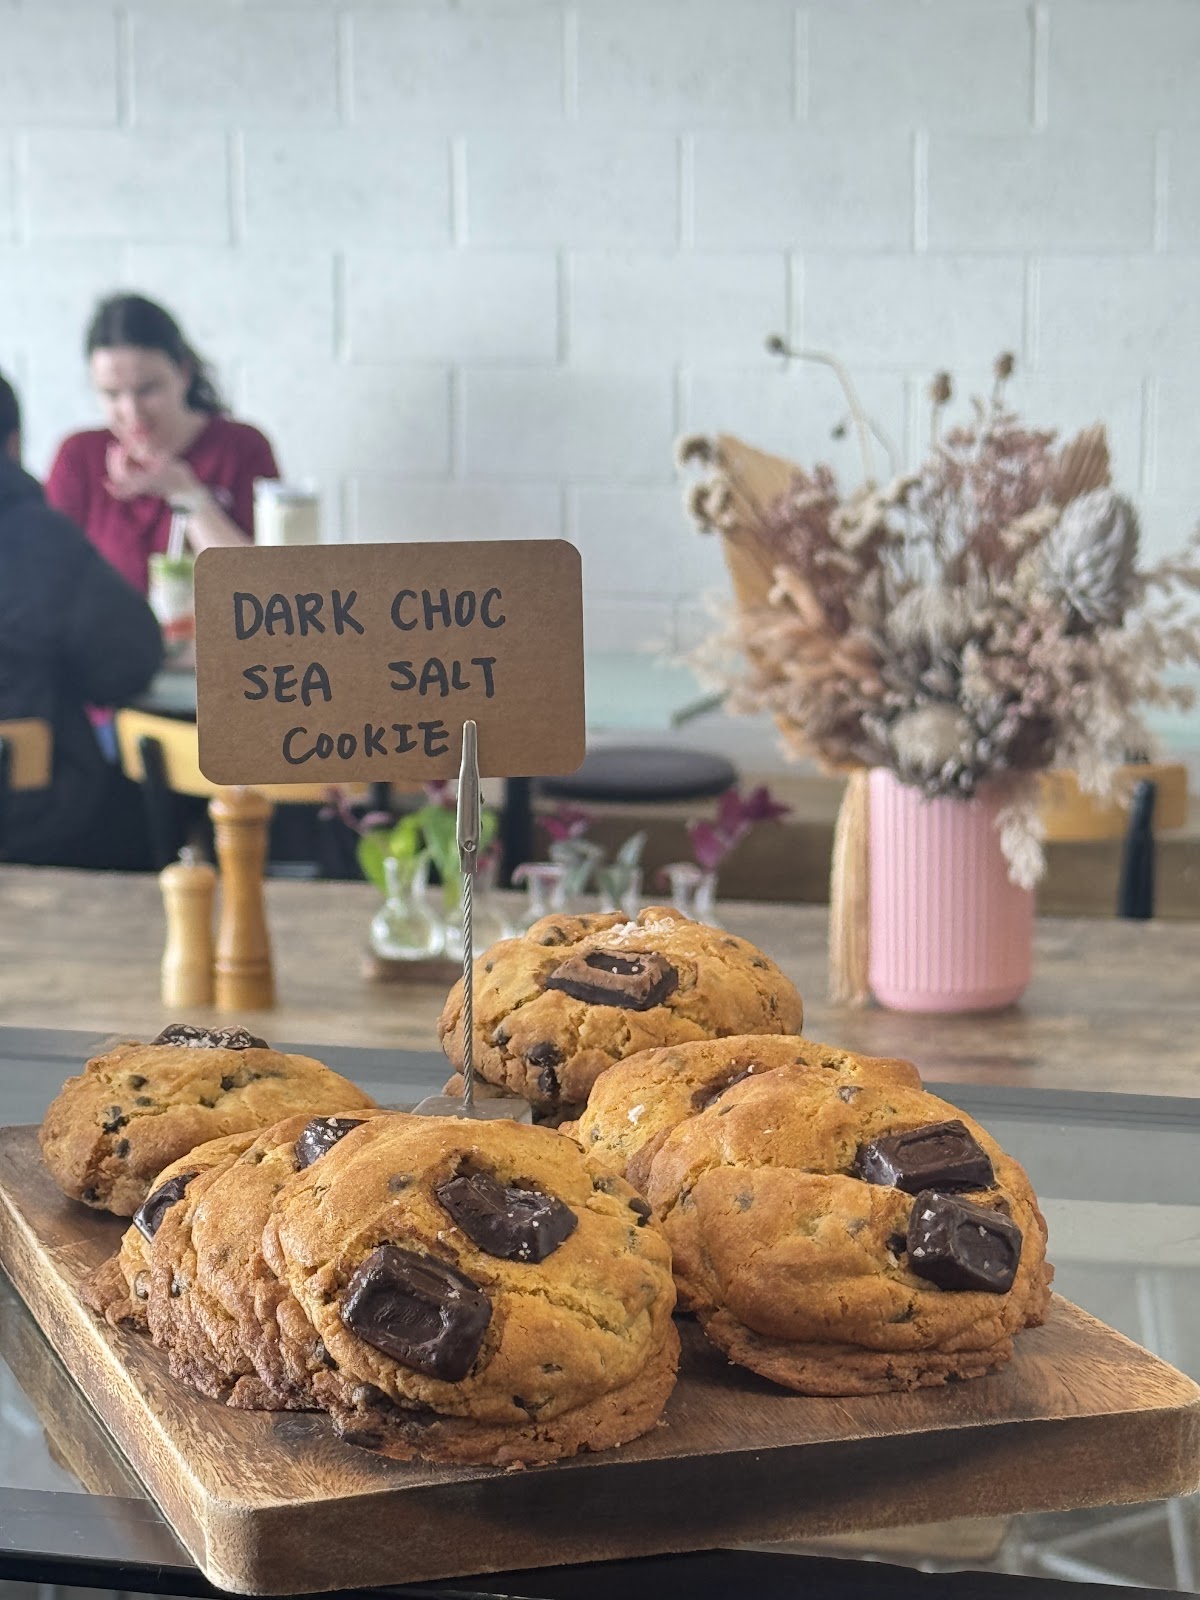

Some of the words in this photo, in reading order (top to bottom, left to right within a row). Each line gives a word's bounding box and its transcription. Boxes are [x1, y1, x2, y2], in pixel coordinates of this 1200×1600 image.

[233, 589, 365, 641] DARK
[390, 587, 507, 632] CHOC
[242, 662, 333, 708] SEA
[387, 656, 497, 699] SALT
